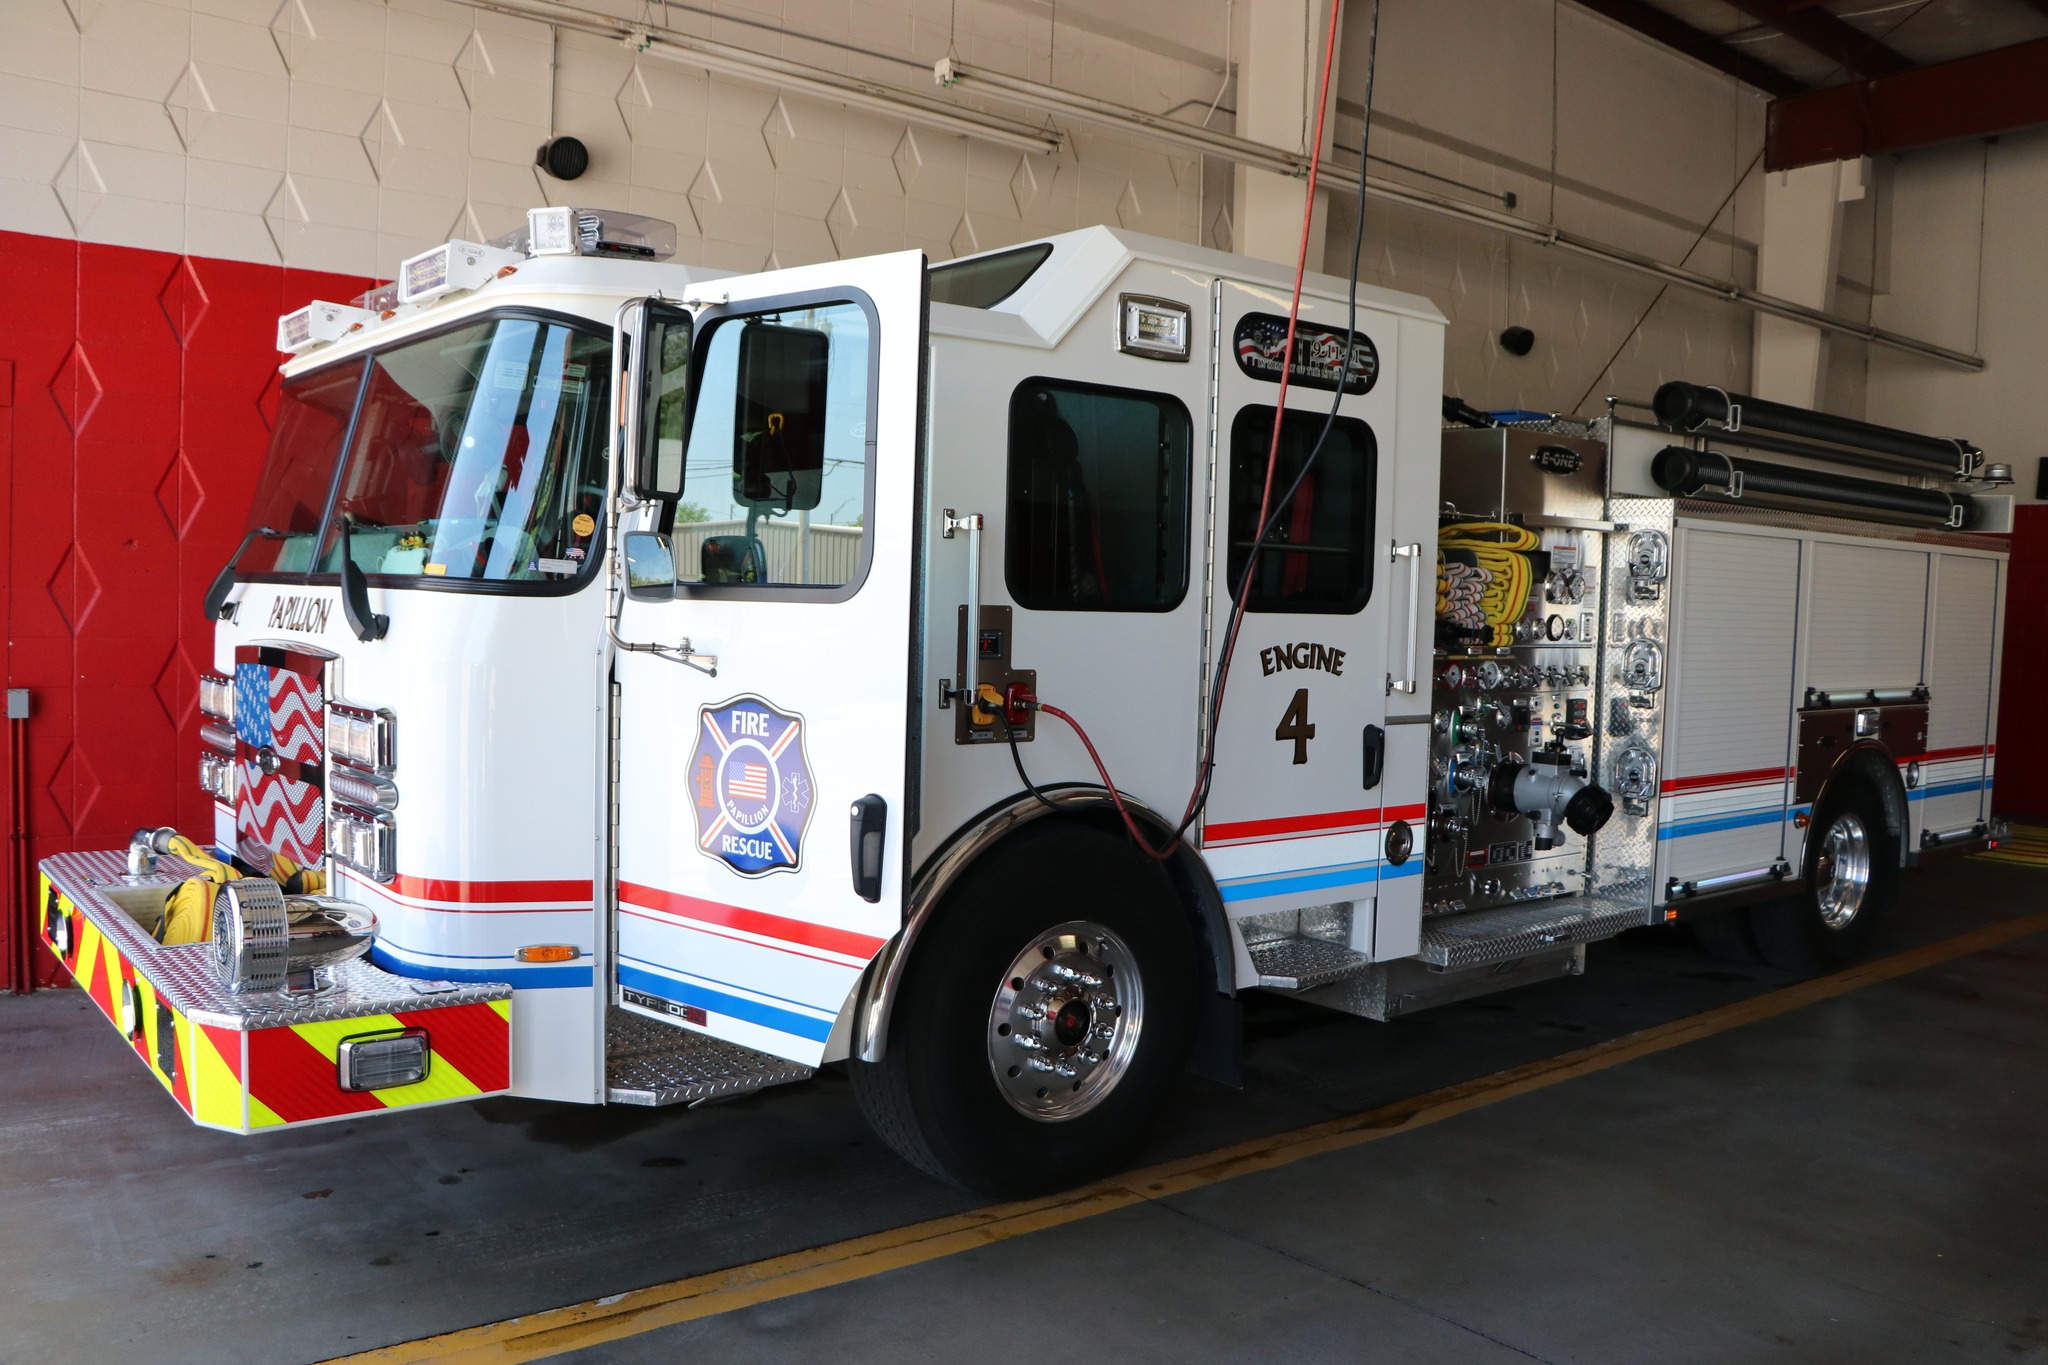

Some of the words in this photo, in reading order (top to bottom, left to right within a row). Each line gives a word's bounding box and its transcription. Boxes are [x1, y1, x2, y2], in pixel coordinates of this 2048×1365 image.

[1296, 364, 1305, 375] OF
[1306, 366, 1320, 378] THE
[1541, 452, 1576, 468] E-ONE
[267, 595, 334, 635] PAPILLION
[1260, 641, 1347, 677] ENGINE
[731, 710, 770, 737] FIRE
[1275, 688, 1316, 765] 4
[726, 799, 770, 826] PAPILLION
[722, 834, 773, 861] RESCUE
